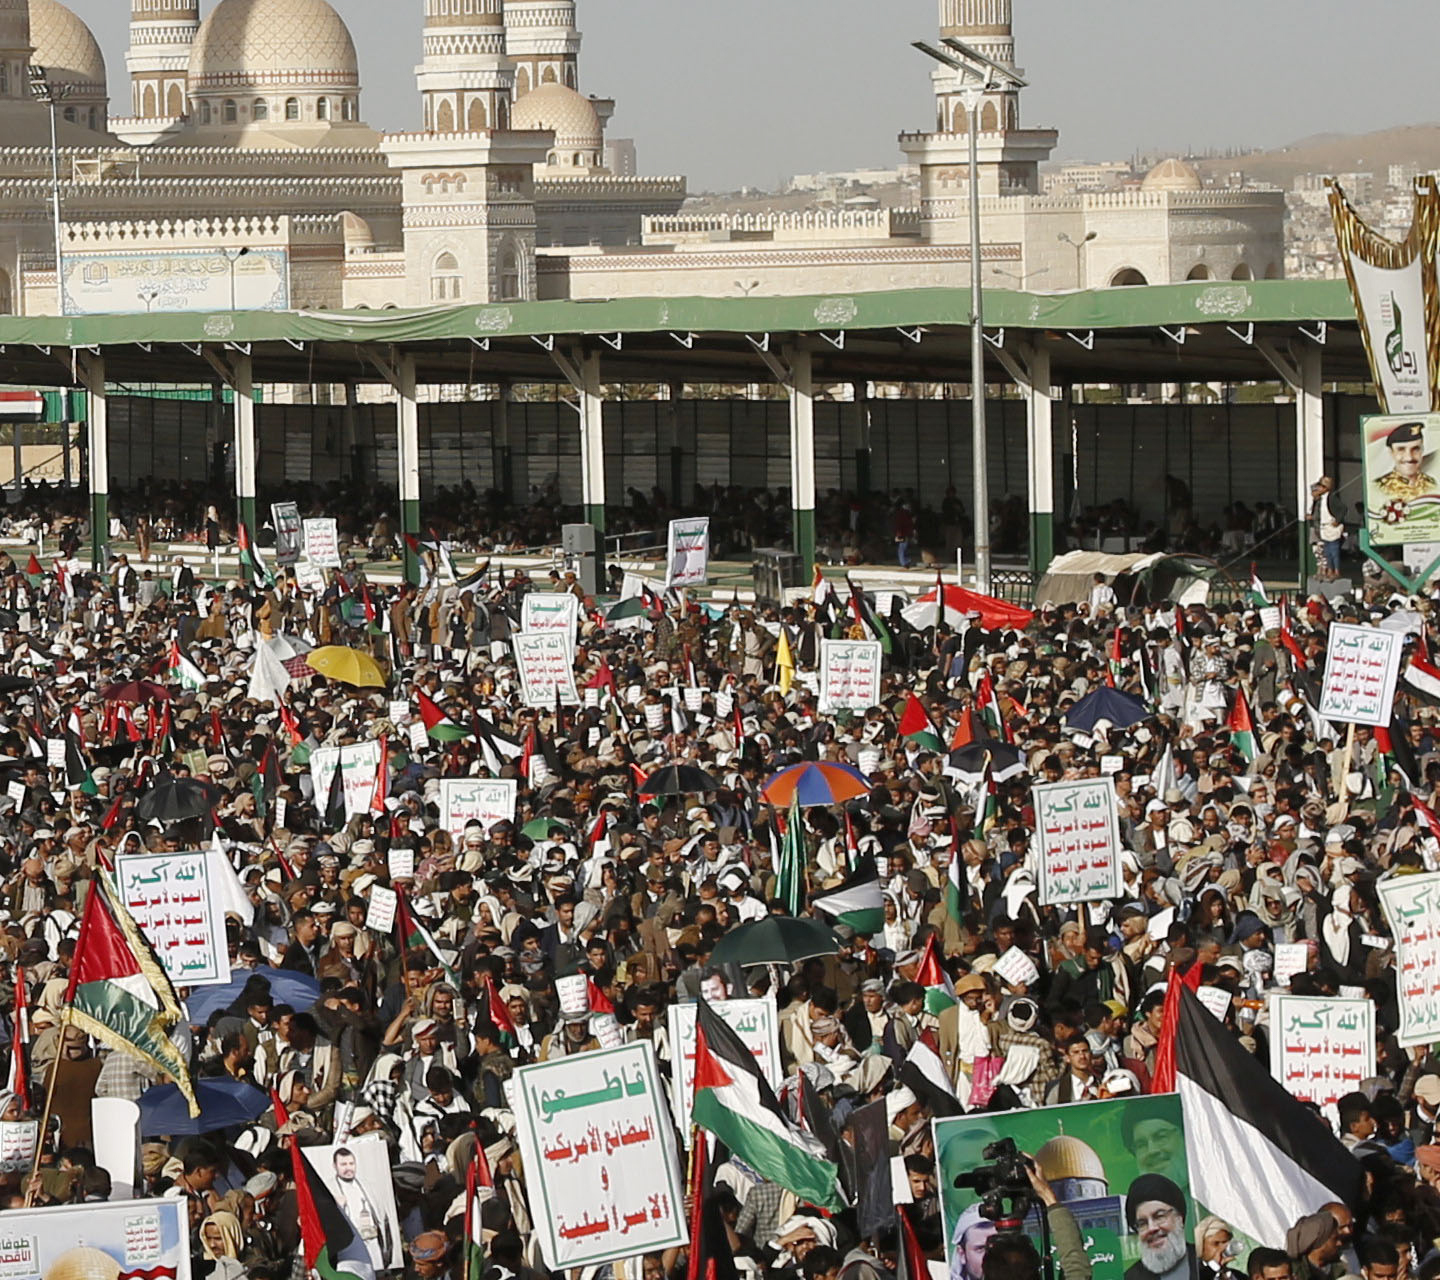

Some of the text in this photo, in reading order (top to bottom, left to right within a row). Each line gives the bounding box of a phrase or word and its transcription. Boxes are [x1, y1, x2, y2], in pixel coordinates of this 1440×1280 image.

[531, 1062, 647, 1123] قاطعوا
[604, 1115, 655, 1156] البضائع
[601, 1165, 609, 1191] و
